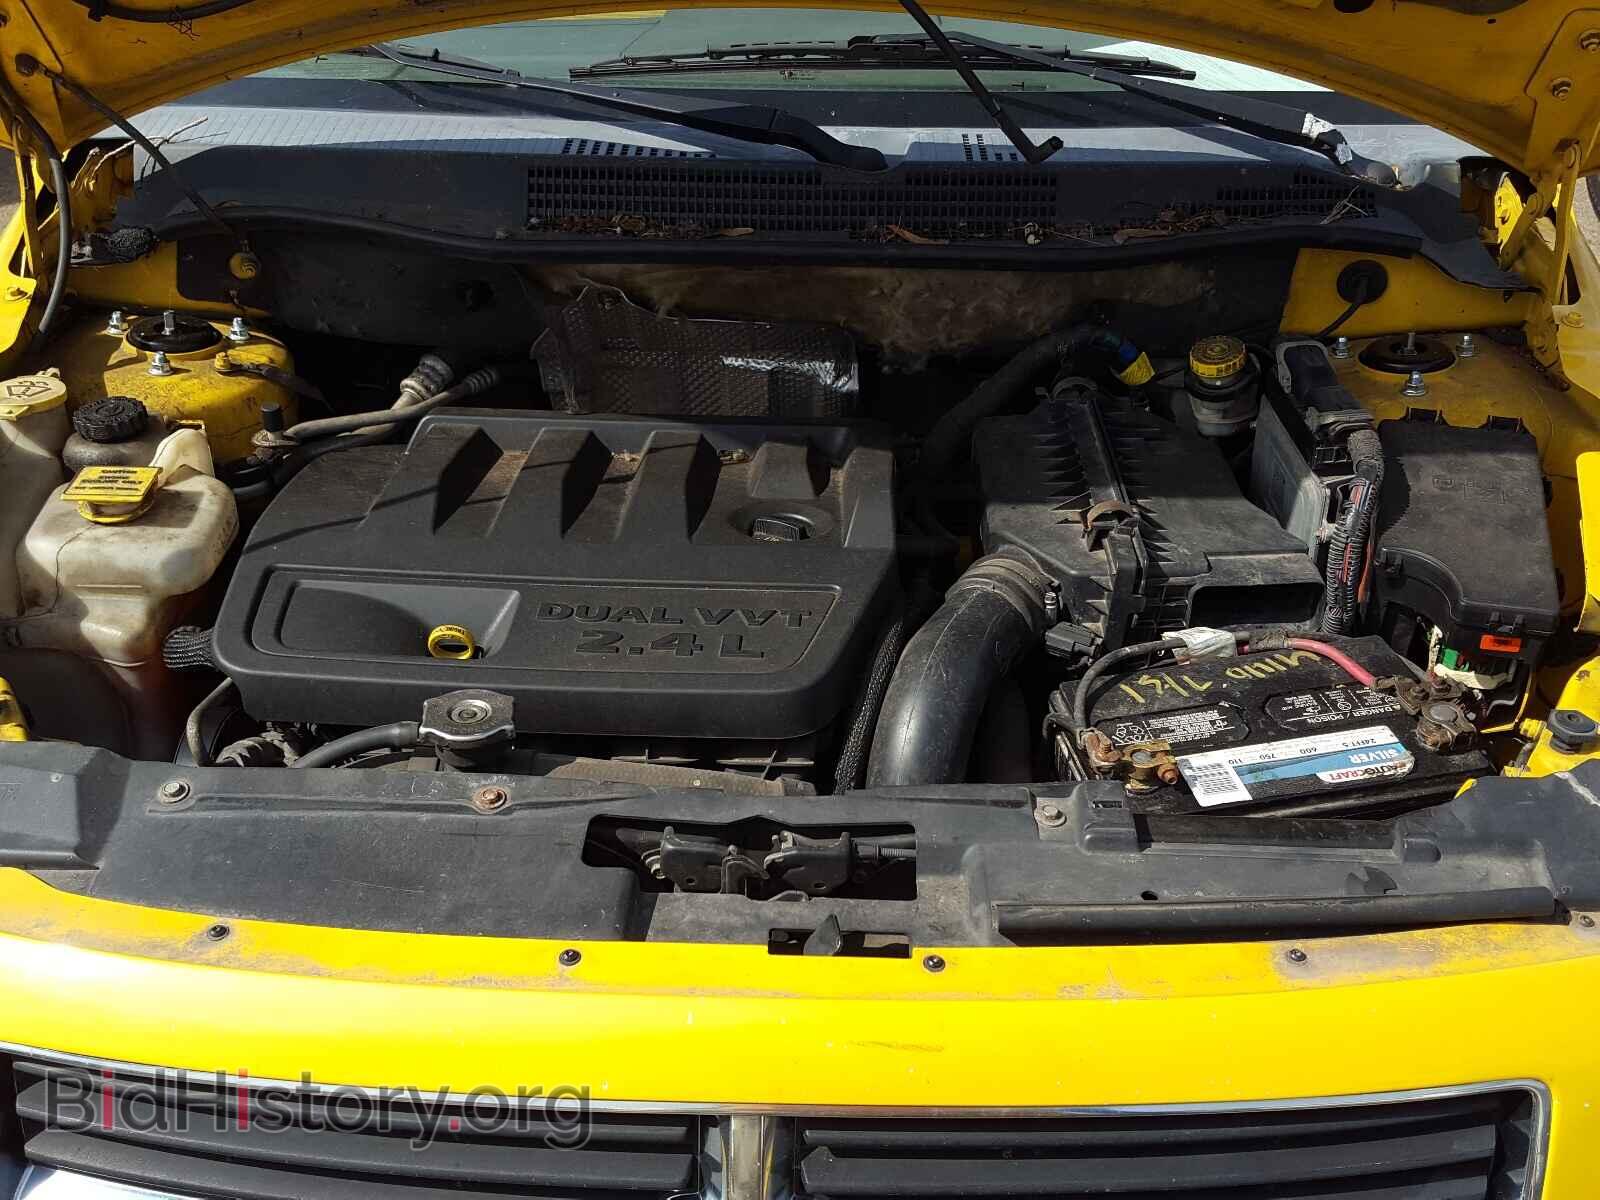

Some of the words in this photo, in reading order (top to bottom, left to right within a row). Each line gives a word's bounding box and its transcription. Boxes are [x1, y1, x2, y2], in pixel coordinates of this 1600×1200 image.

[537, 602, 683, 624] DUAL
[696, 607, 812, 628] VVT
[1352, 706, 1393, 717] DANGER
[1307, 713, 1345, 724] POISON
[1299, 746, 1317, 755] 600
[1348, 748, 1400, 764] SILVER
[1259, 753, 1277, 761] 750
[1328, 764, 1397, 781] AUTOCRAFT
